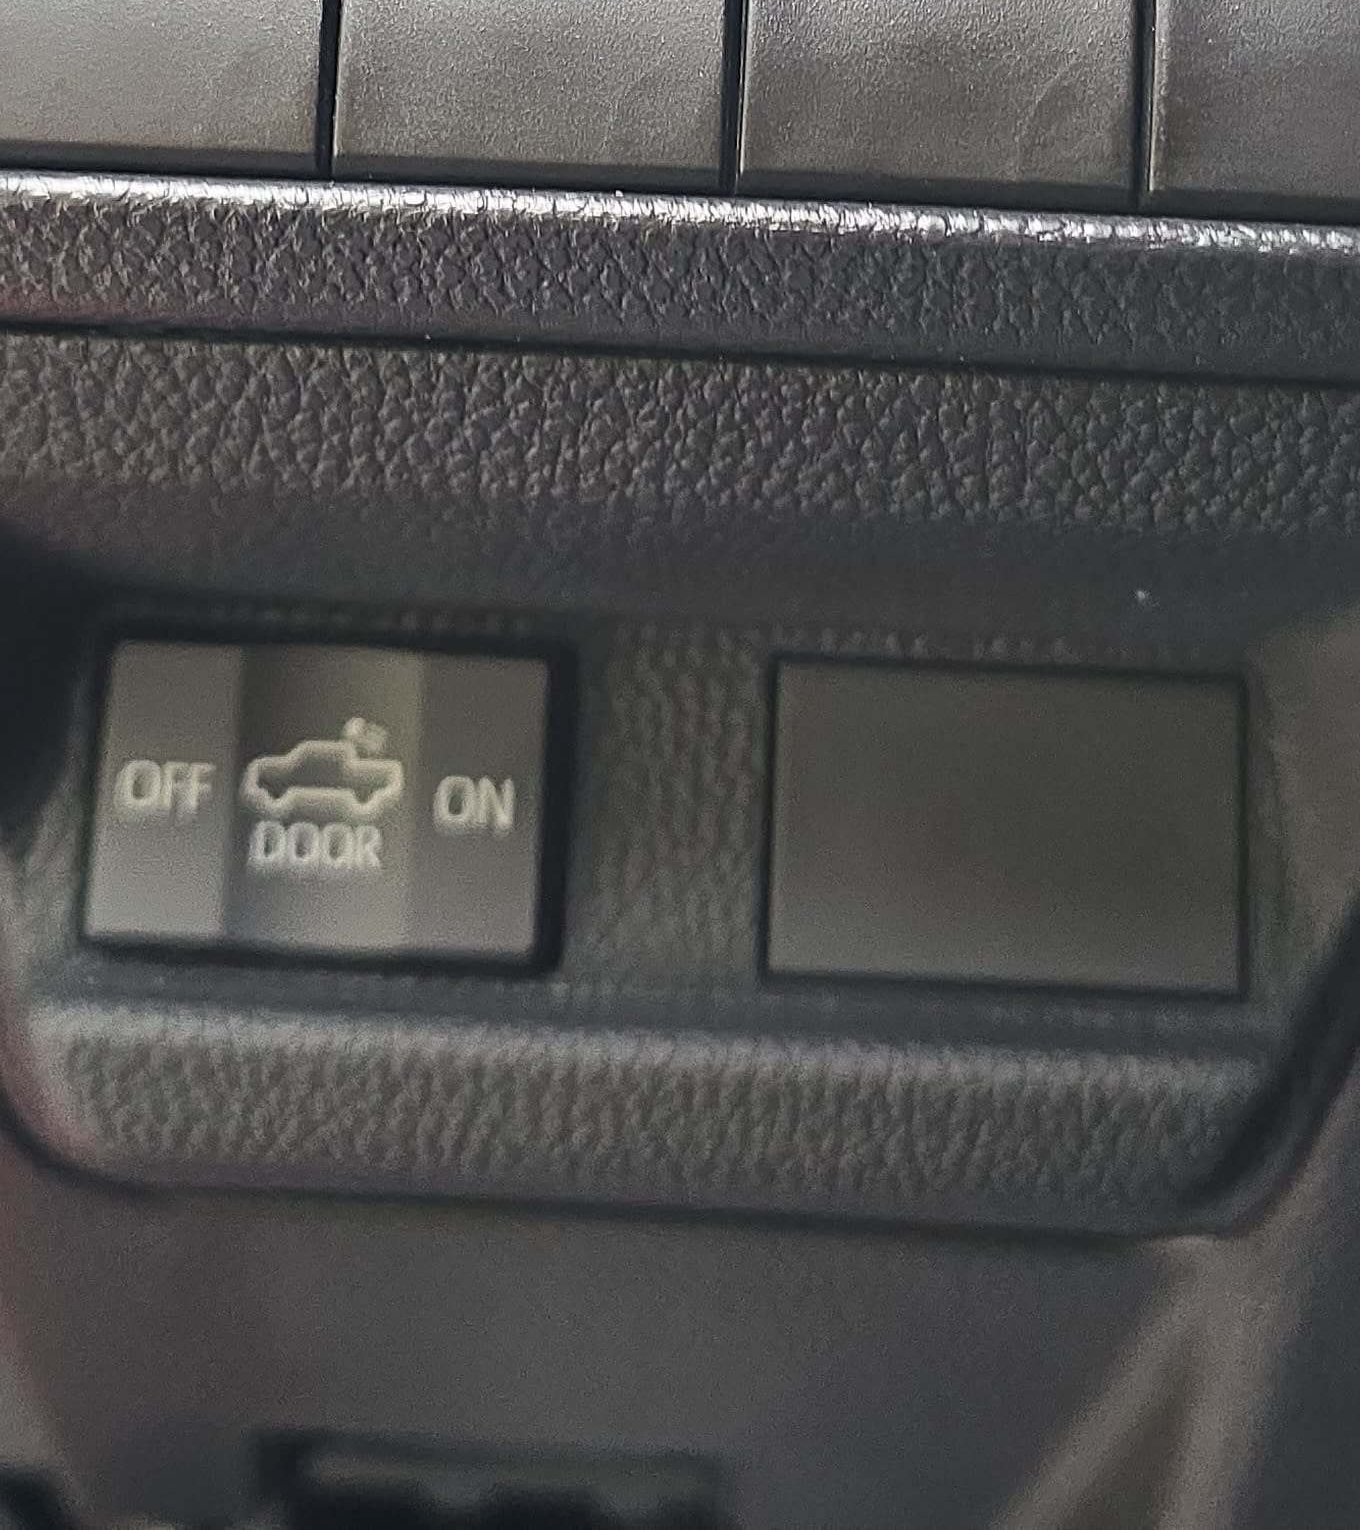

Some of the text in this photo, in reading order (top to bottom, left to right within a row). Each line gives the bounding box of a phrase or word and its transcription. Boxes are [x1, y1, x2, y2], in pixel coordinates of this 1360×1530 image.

[115, 759, 215, 815] OFF
[434, 775, 515, 834] ON
[248, 820, 383, 871] DOOR
